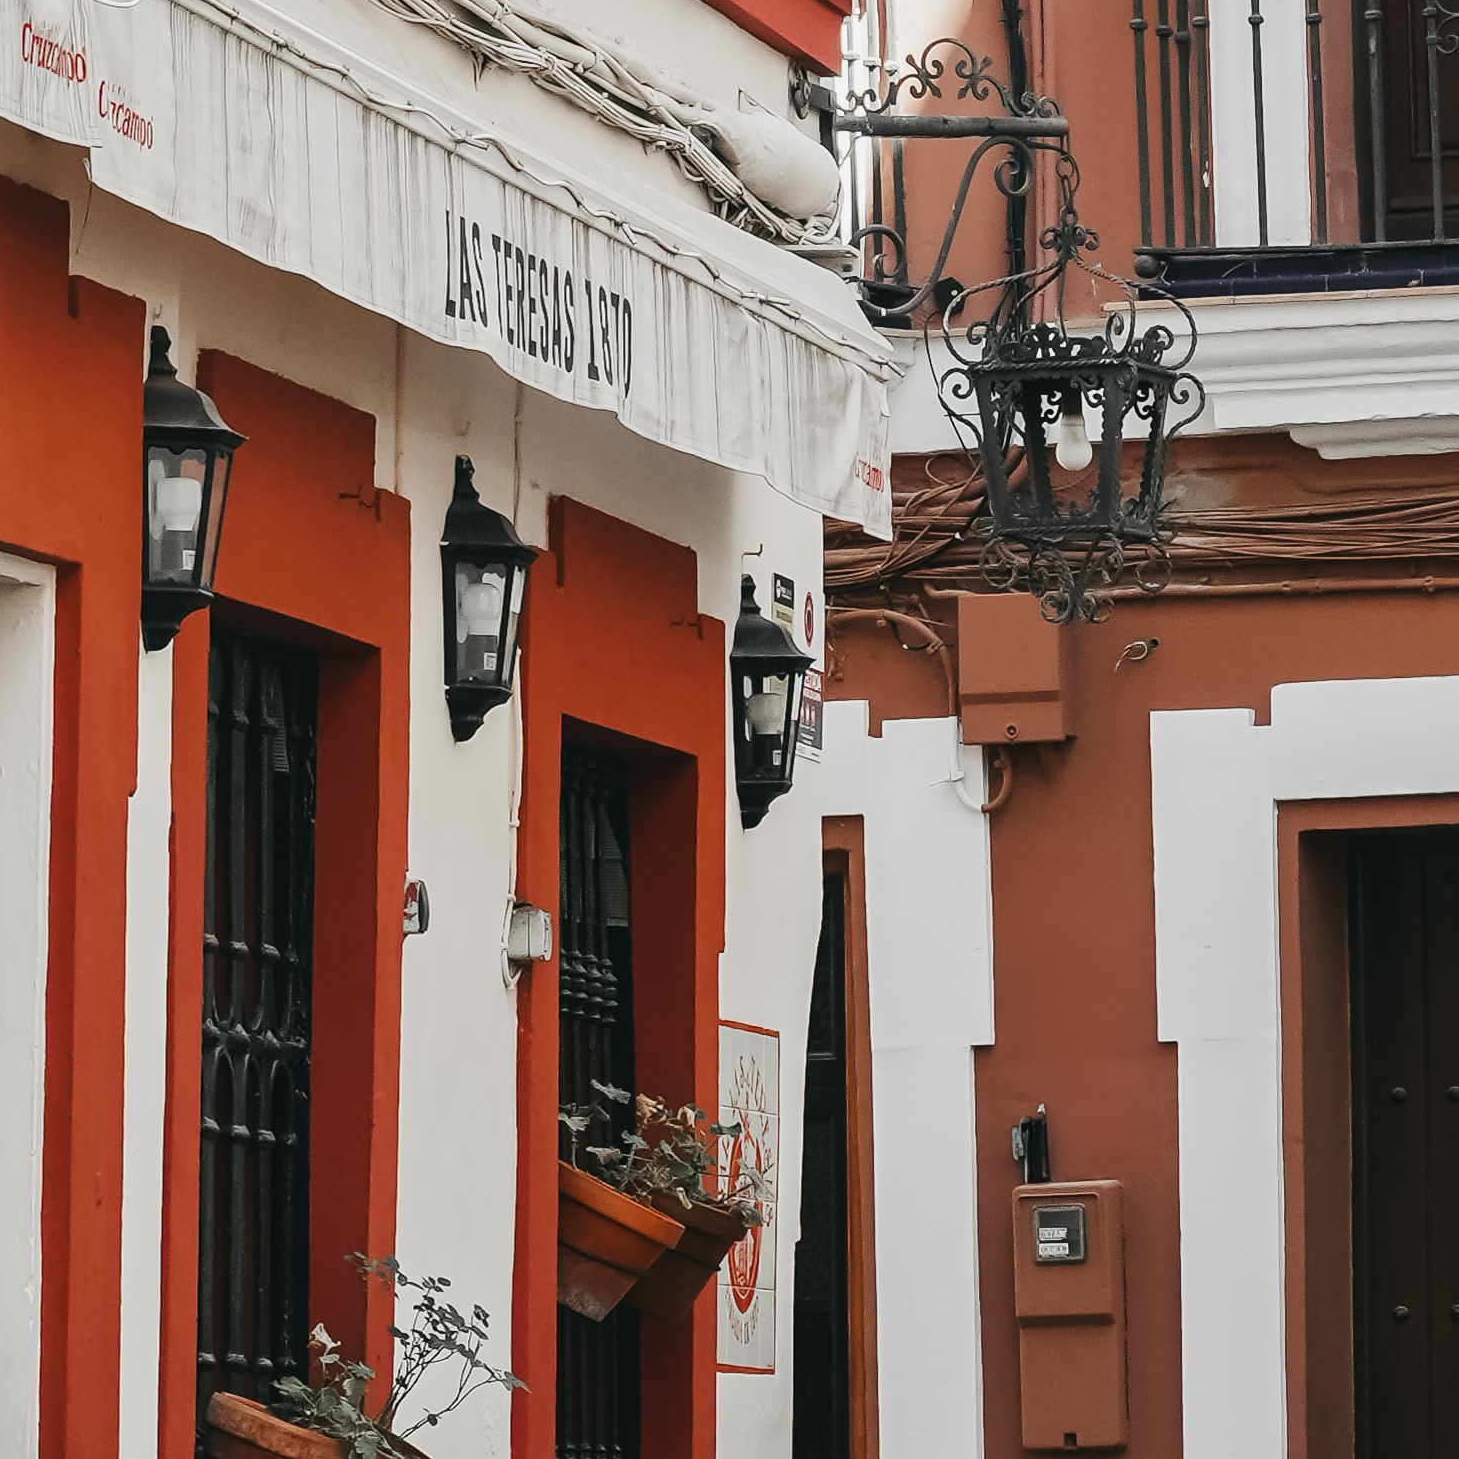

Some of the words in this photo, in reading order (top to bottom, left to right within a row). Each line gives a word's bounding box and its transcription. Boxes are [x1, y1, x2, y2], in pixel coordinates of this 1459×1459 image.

[98, 80, 154, 152] Czcampo
[445, 210, 488, 328] LAS
[491, 233, 575, 374] TERESAS
[585, 278, 632, 399] 1870
